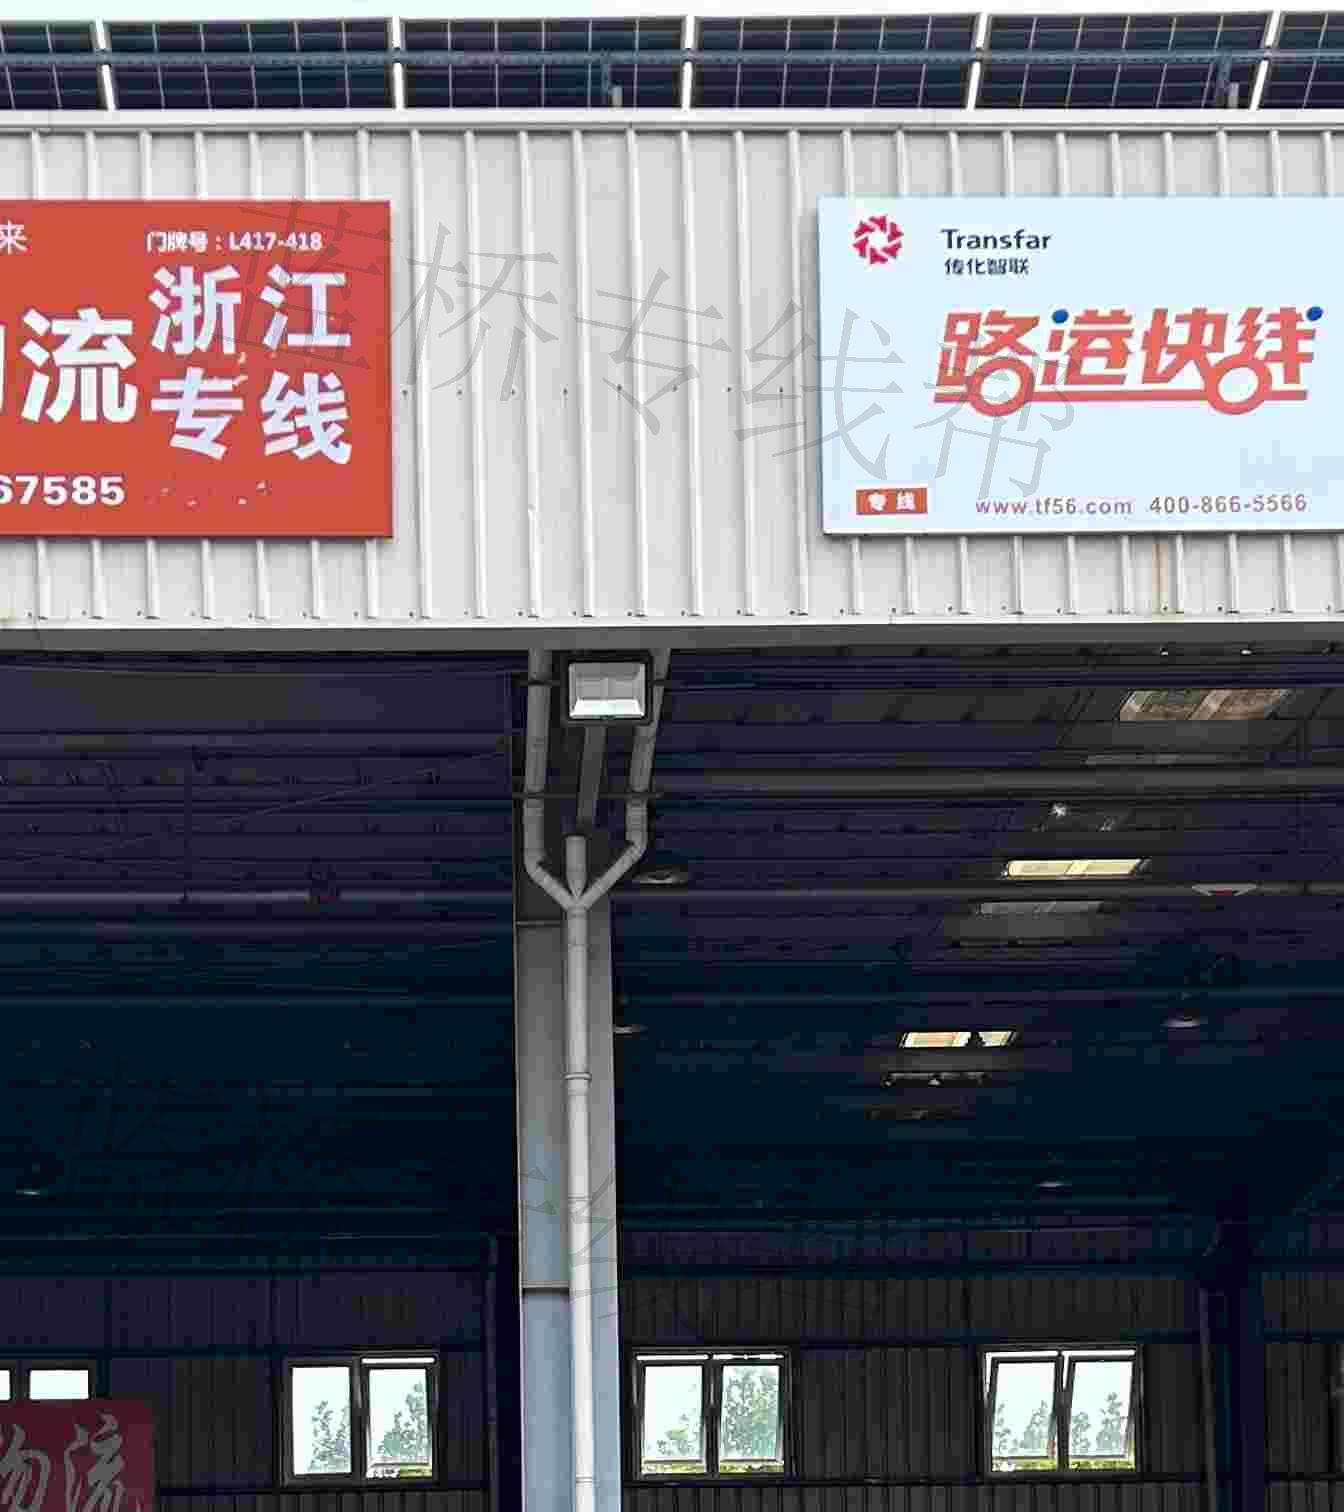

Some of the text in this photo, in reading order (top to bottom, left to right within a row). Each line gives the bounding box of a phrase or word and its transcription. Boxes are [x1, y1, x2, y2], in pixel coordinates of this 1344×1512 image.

[940, 228, 1052, 249] Transfar
[944, 257, 1029, 275] 传化智联
[149, 262, 353, 356] 浙江
[933, 304, 1324, 415] 路港快线
[149, 367, 354, 466] 专线
[975, 494, 1307, 515] www.tf56.com 400-866-5566
